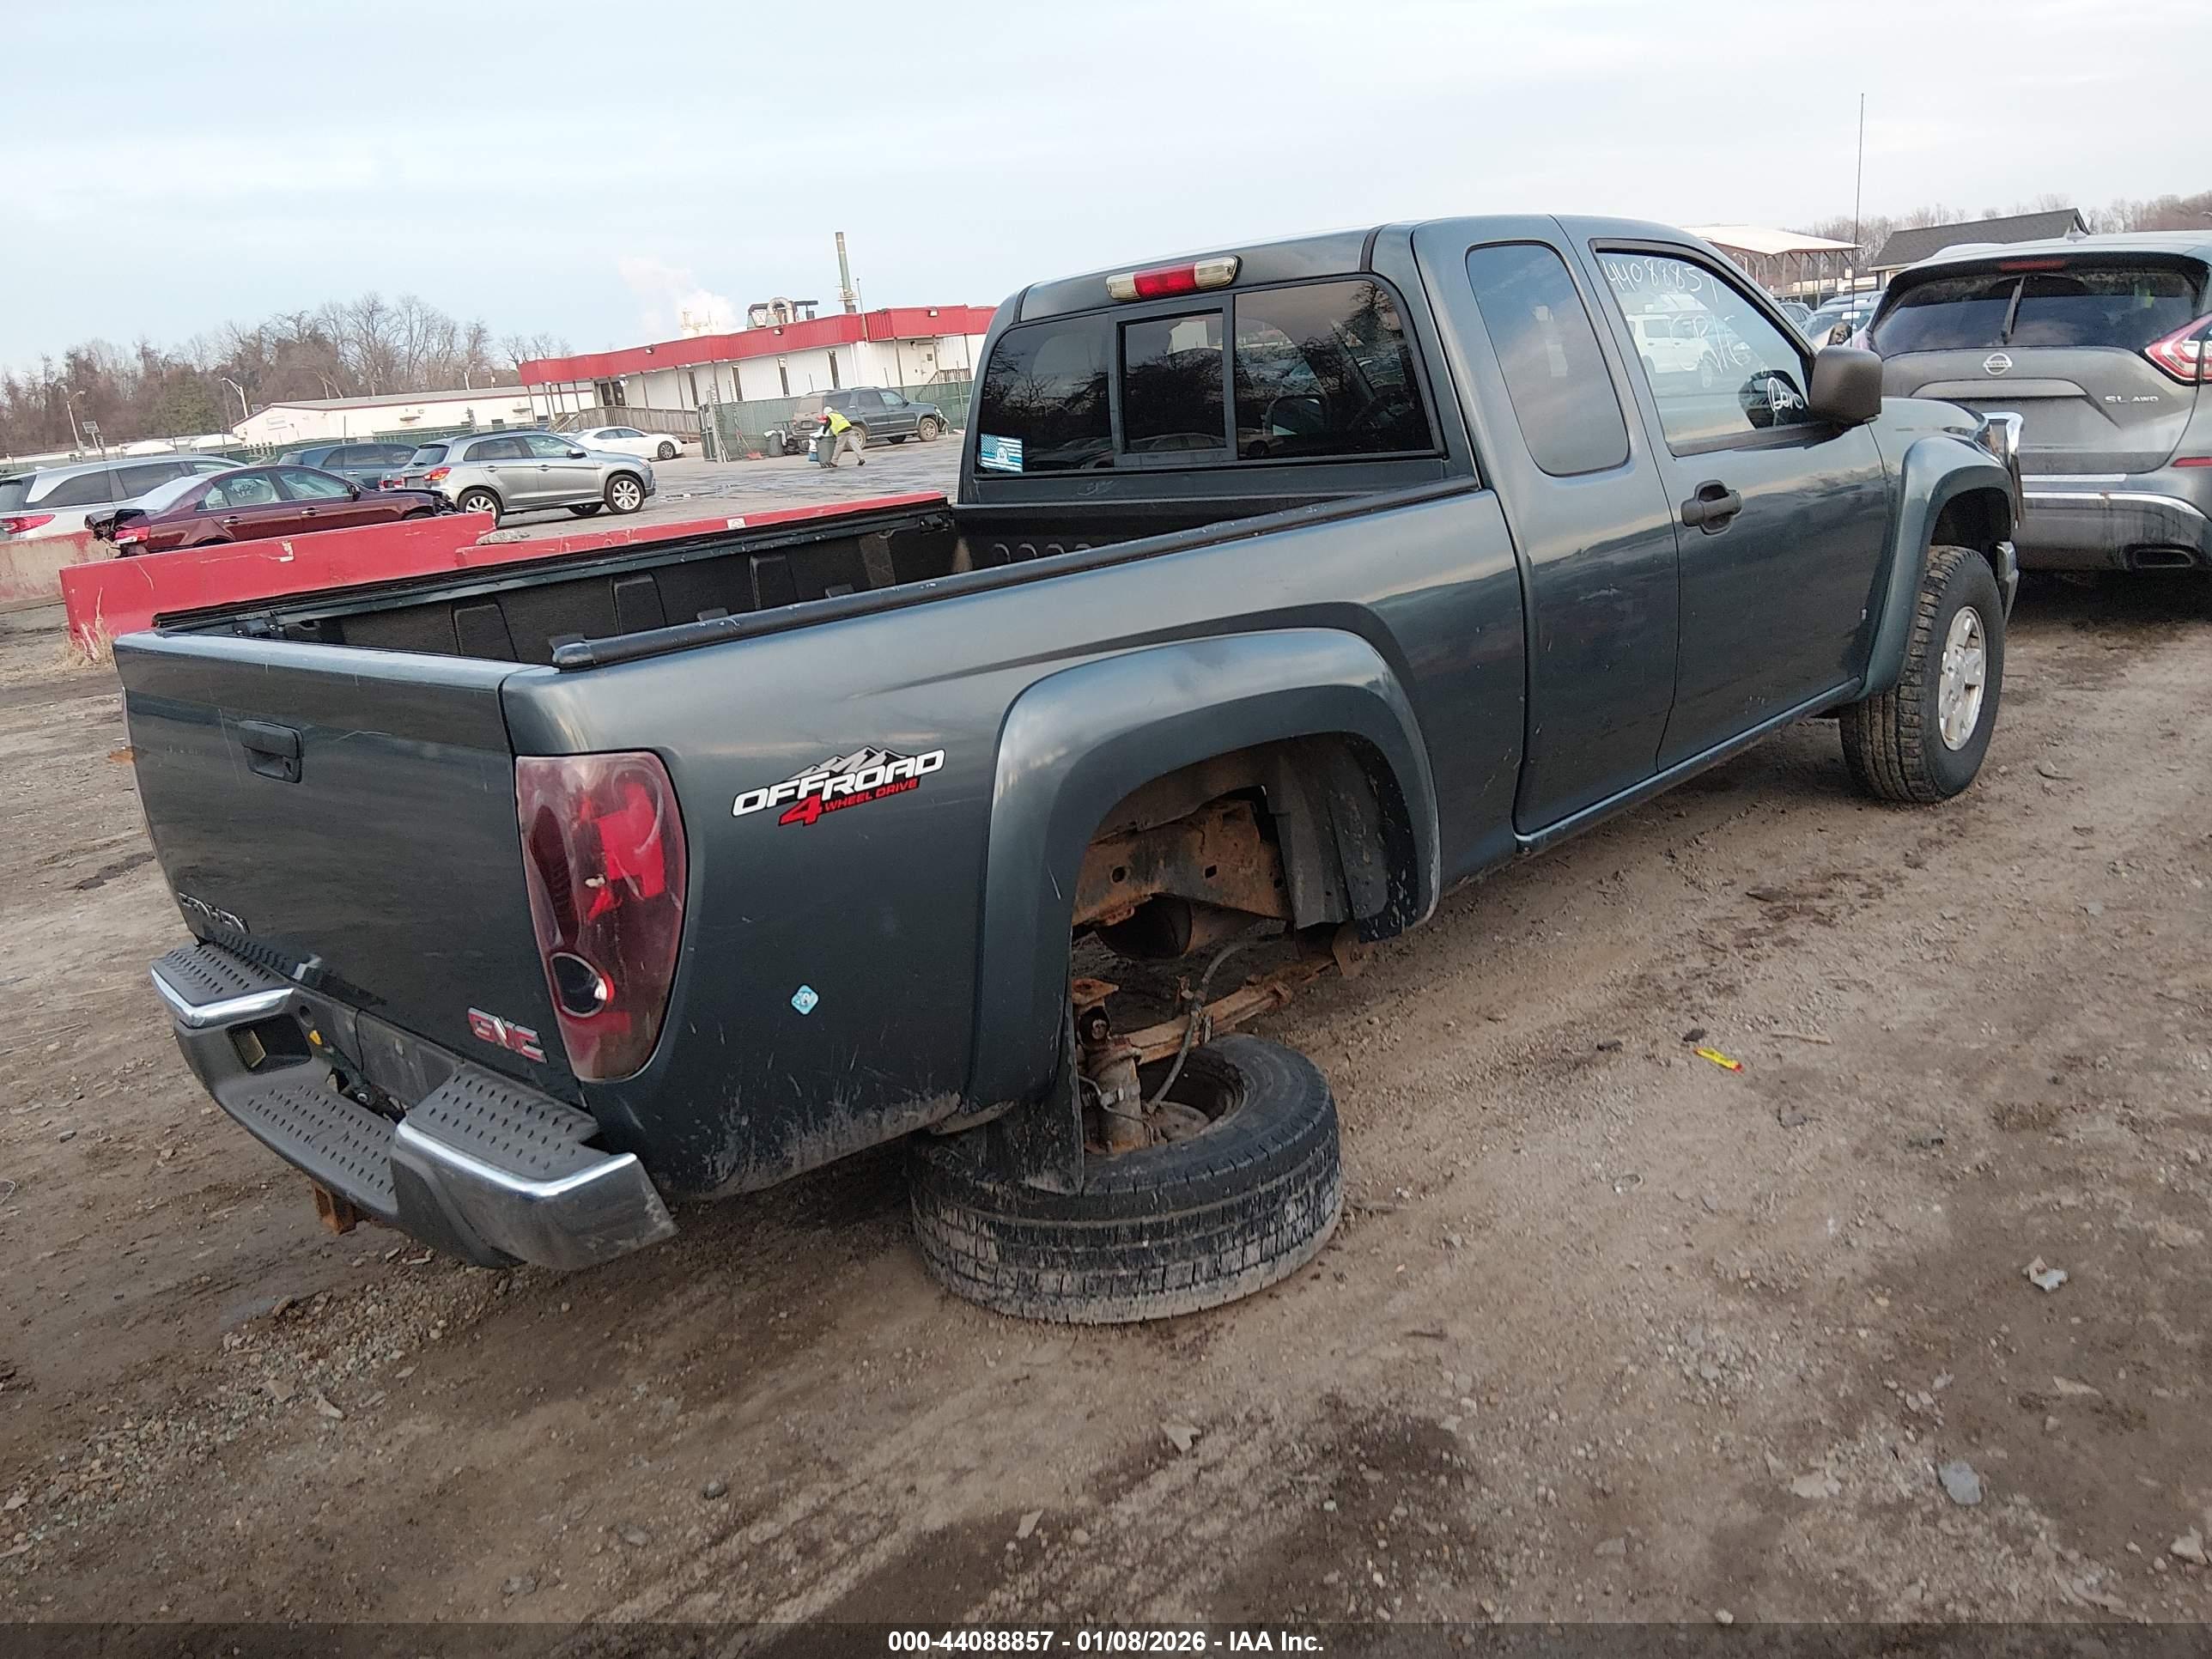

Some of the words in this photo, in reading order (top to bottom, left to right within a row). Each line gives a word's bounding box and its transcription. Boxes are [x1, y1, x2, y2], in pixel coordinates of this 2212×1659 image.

[2104, 394, 2129, 404] SL
[2130, 395, 2160, 404] AWD
[732, 749, 946, 817] OFFROAD
[779, 794, 822, 826] 4
[823, 793, 872, 812] WHEEL
[874, 778, 919, 799] DRIVE
[467, 1006, 548, 1064] GMC
